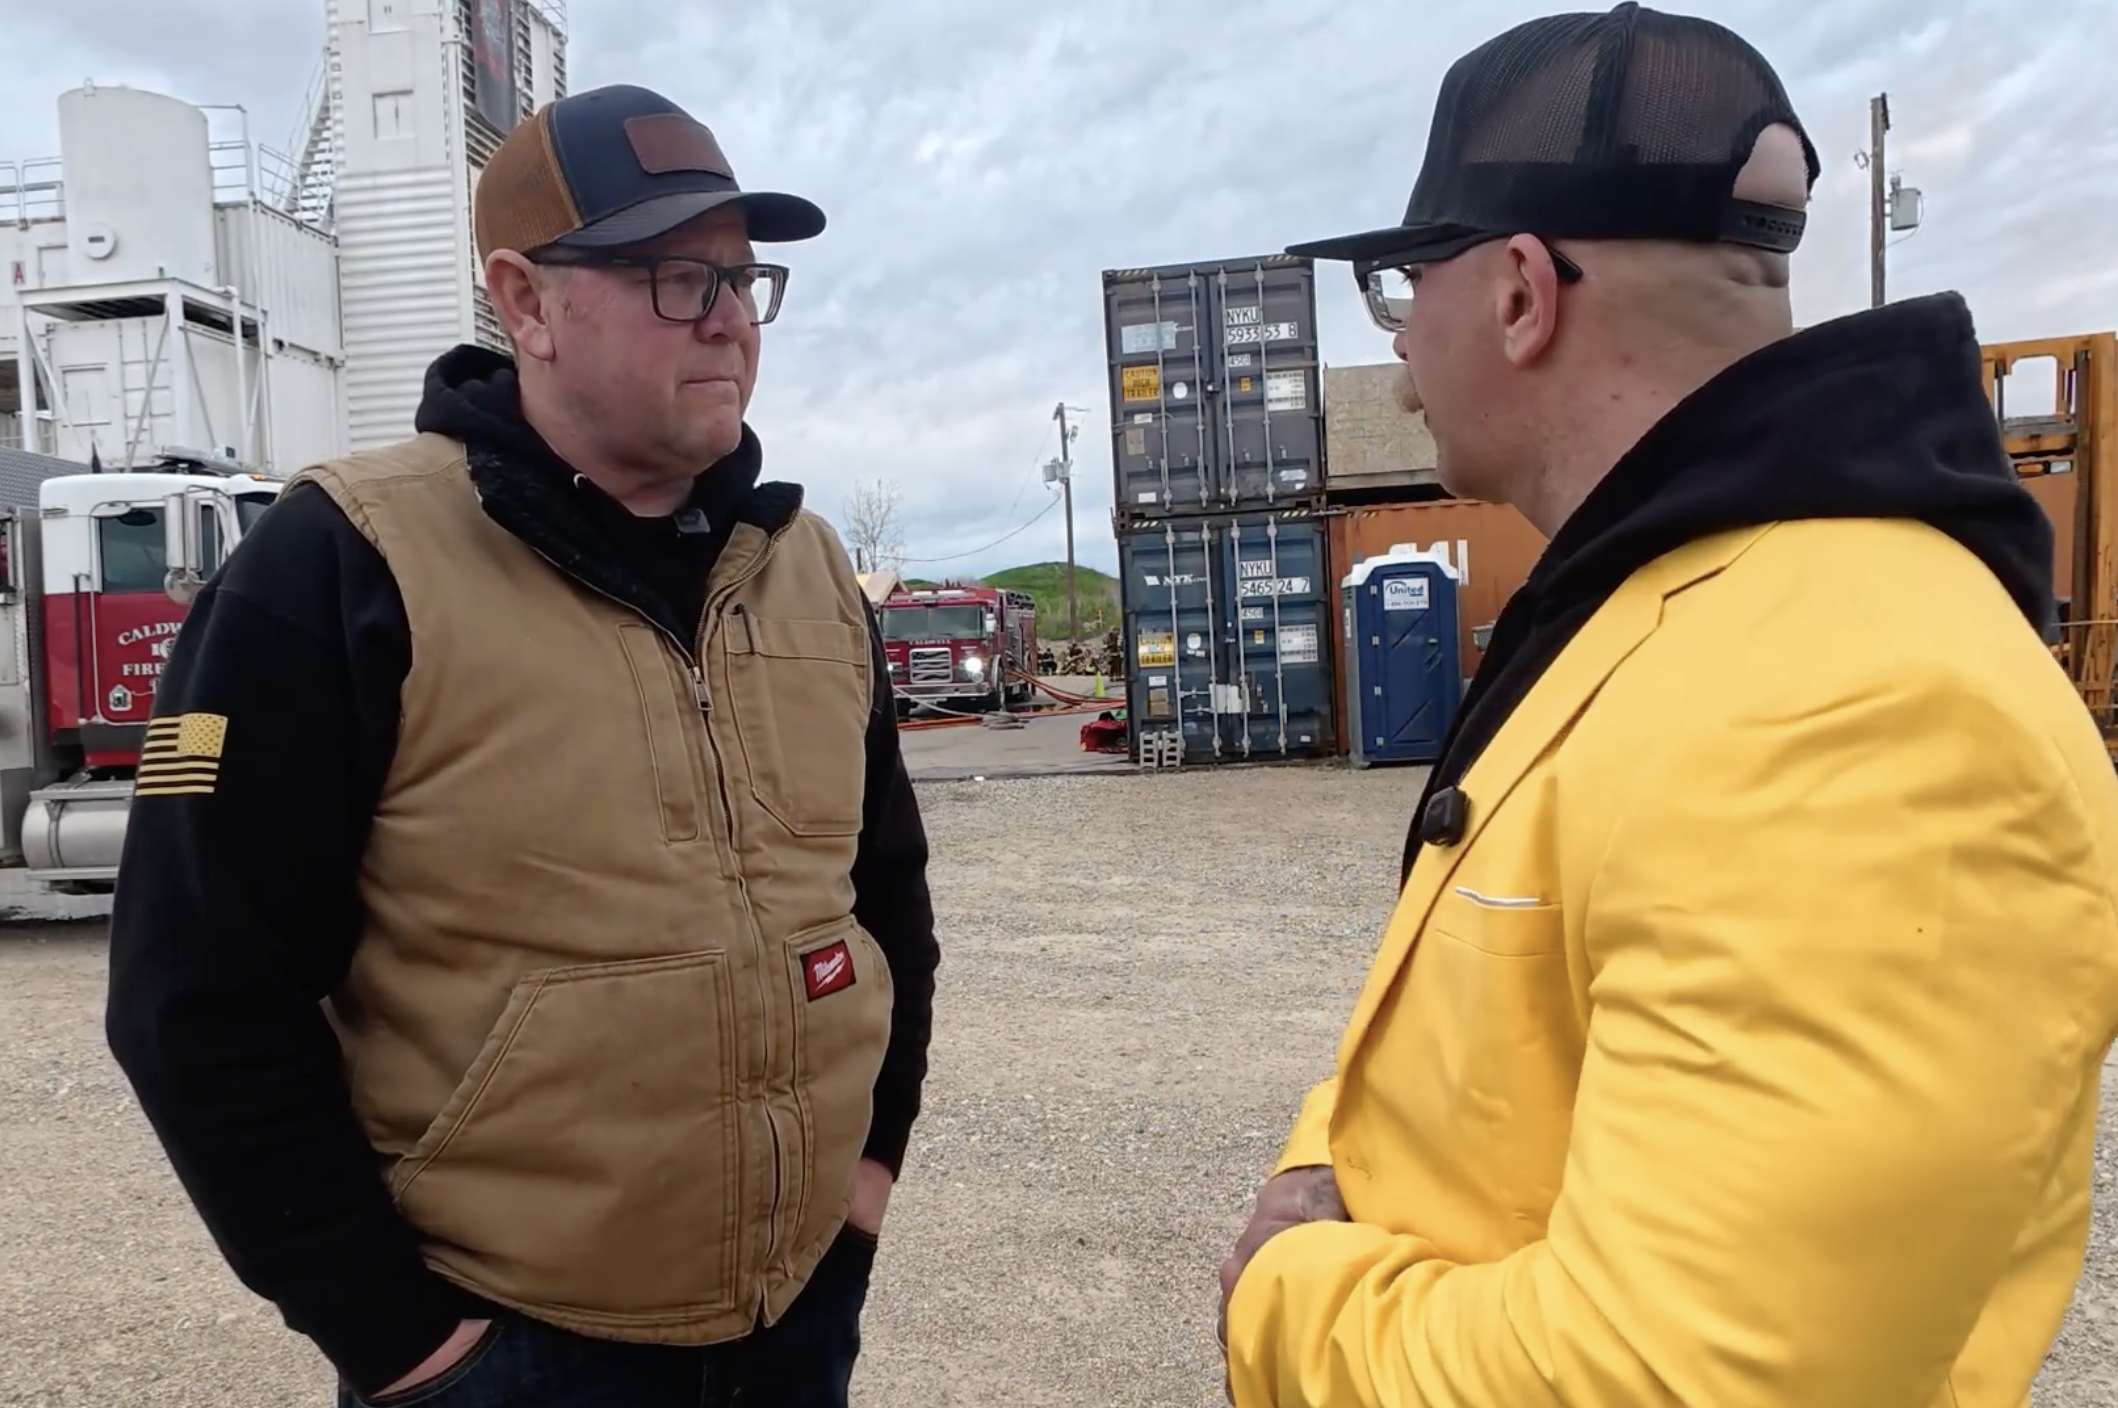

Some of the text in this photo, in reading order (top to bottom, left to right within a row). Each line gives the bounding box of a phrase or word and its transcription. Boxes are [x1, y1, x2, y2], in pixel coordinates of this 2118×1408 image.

[14, 262, 25, 284] A
[1227, 307, 1259, 324] NYKU
[1125, 368, 1157, 379] CAUTION
[1126, 387, 1159, 398] TRAILER
[1240, 562, 1272, 577] NYKU
[1390, 584, 1423, 594] United
[118, 622, 183, 645] CALDW
